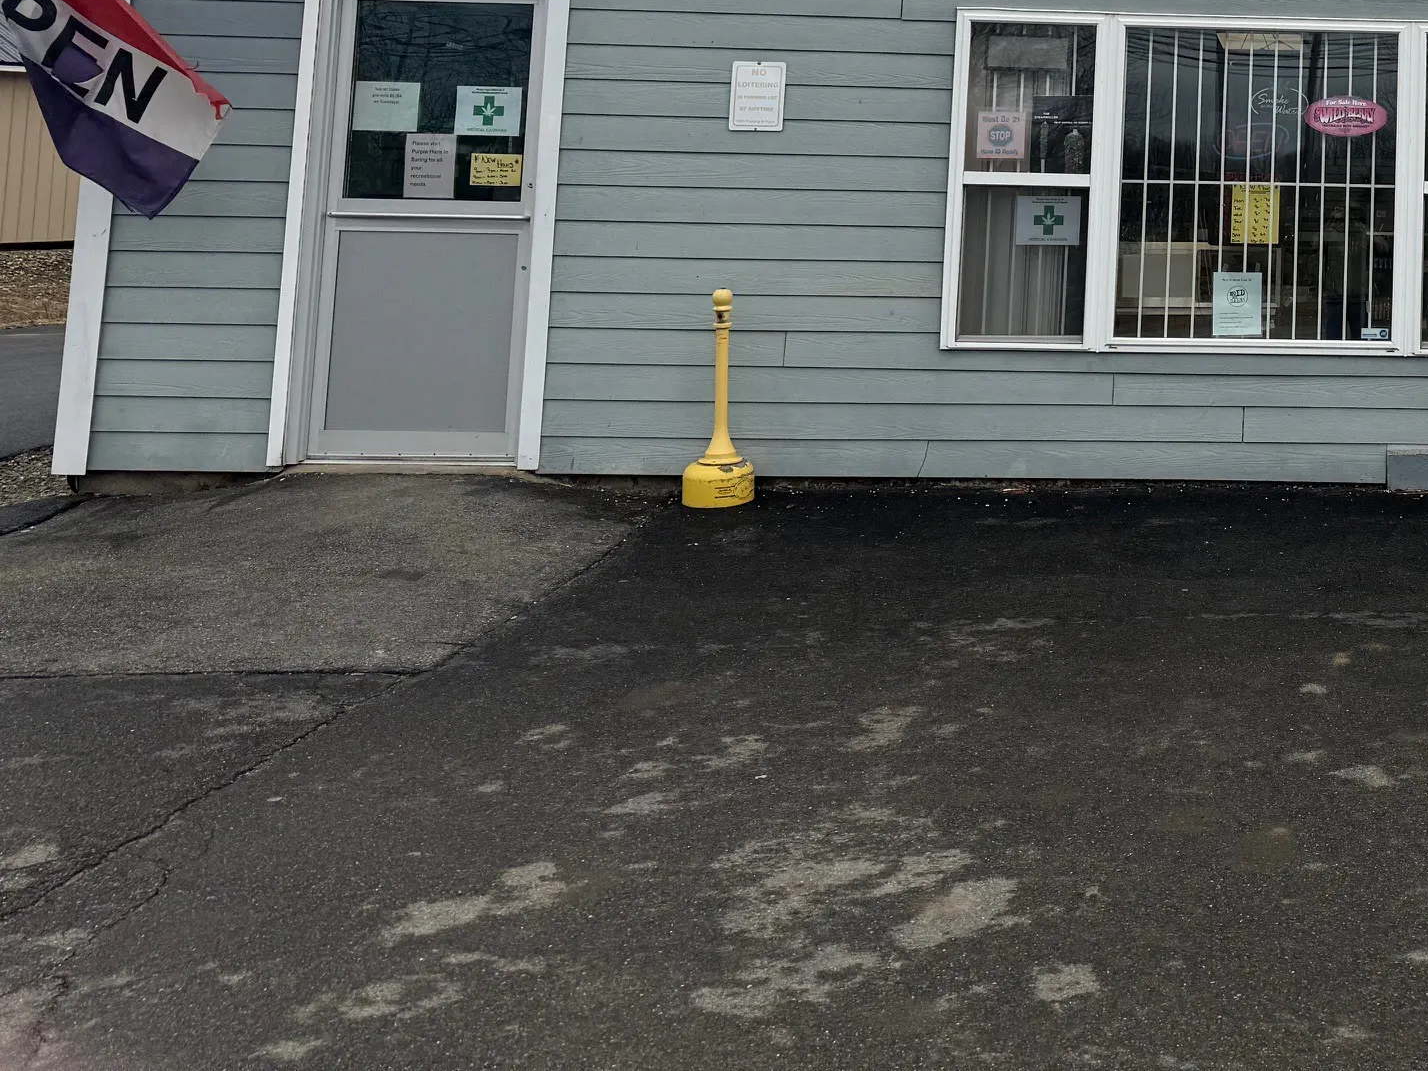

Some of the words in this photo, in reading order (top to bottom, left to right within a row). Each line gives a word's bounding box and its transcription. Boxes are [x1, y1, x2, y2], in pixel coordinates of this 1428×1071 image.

[751, 68, 767, 77] NO
[737, 81, 779, 89] LOITERING
[982, 115, 999, 123] Must
[1012, 115, 1020, 123] 21
[1315, 106, 1346, 124] WILD
[989, 130, 1011, 140] STOP
